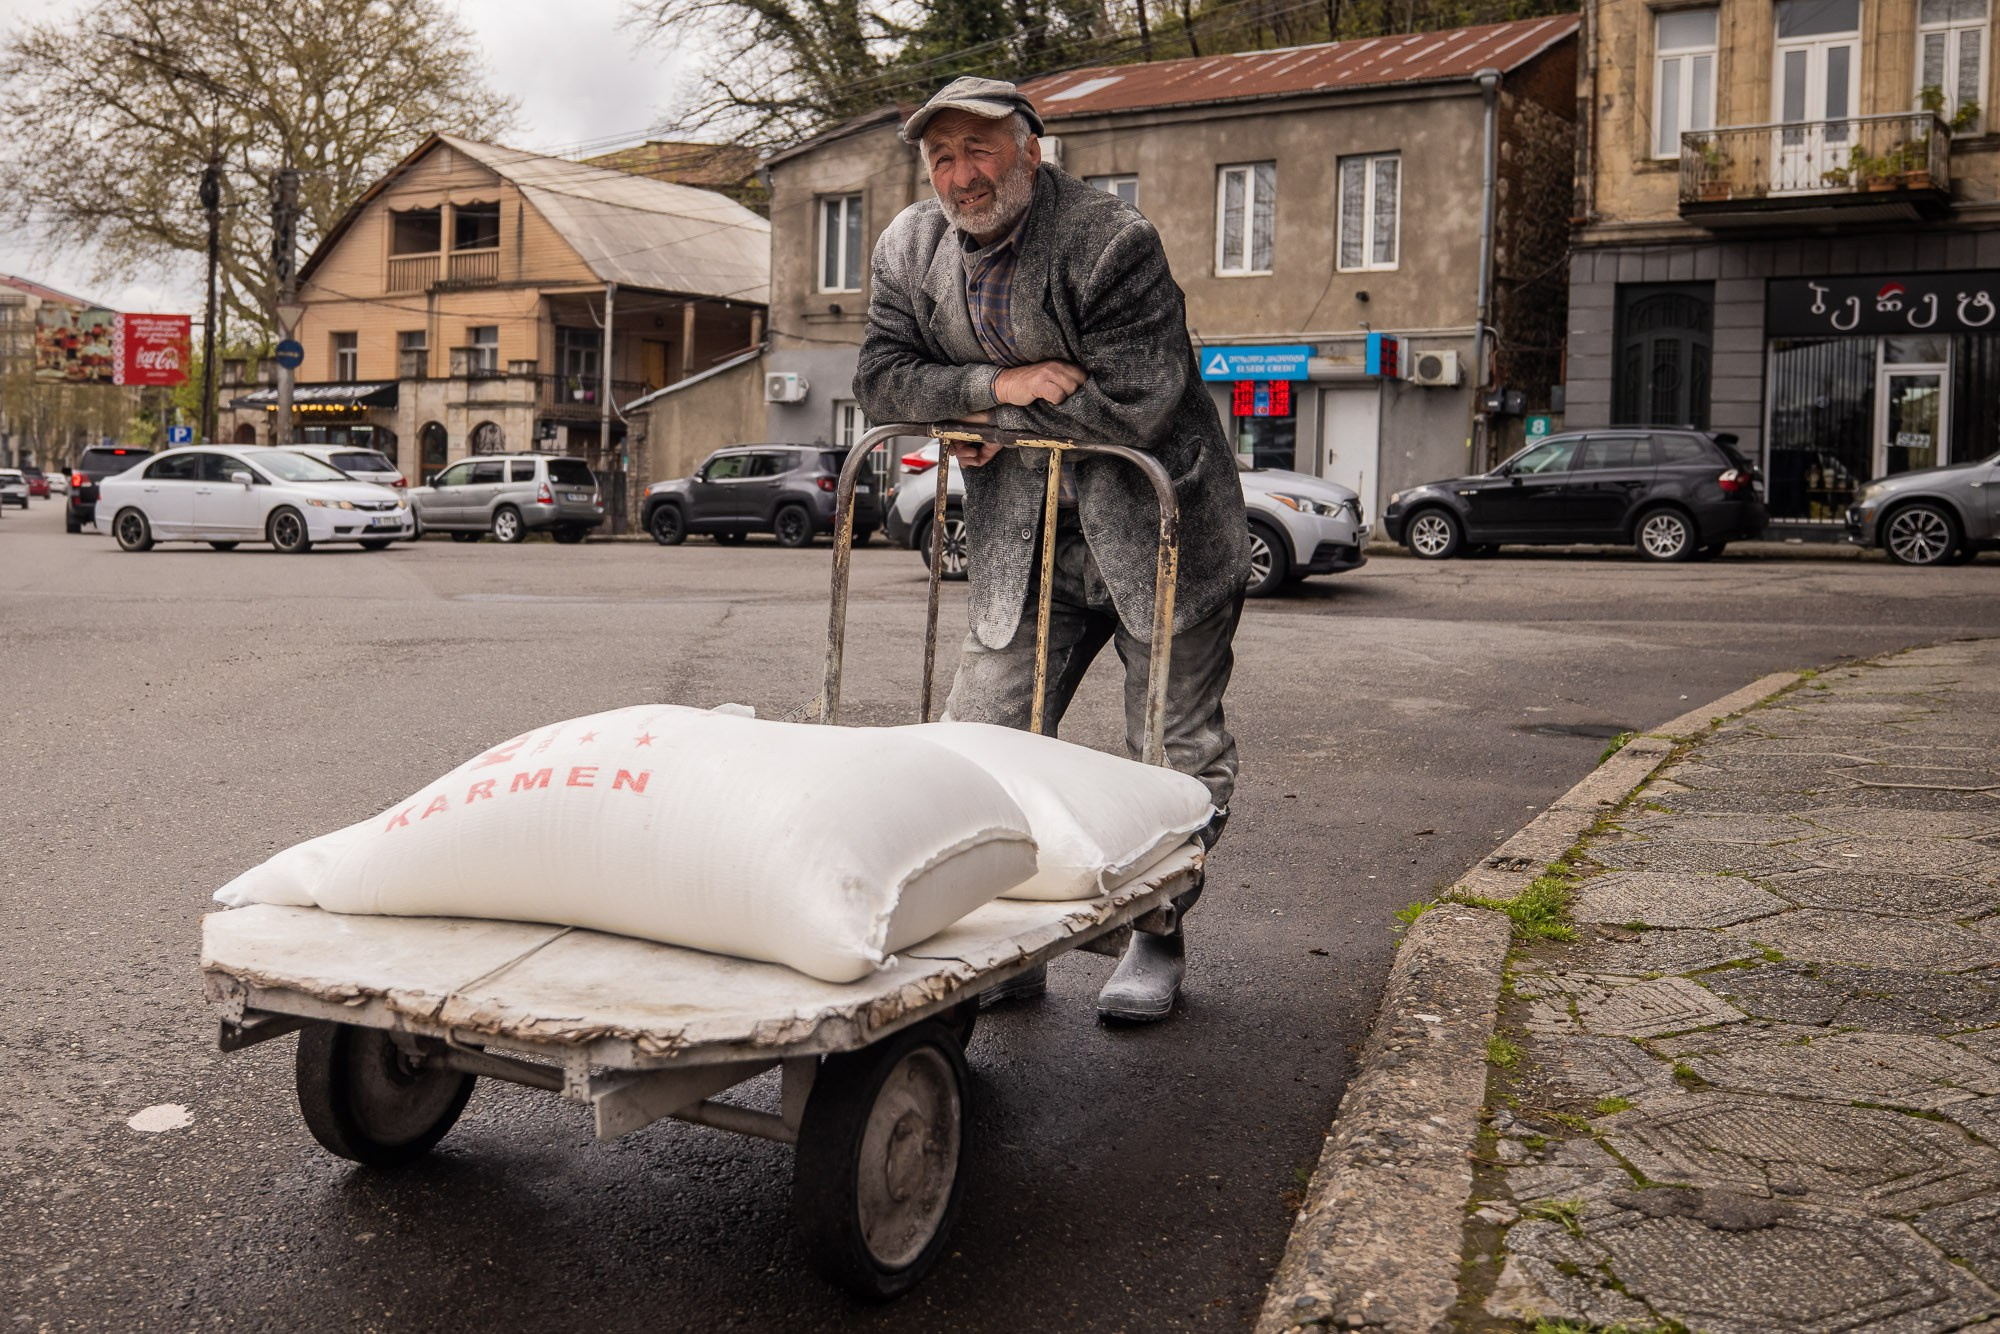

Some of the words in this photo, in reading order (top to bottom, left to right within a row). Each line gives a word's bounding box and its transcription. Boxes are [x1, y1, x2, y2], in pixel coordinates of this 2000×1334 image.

[1267, 363, 1296, 373] CREDIT
[1531, 419, 1545, 434] 8
[175, 427, 187, 442] P
[384, 765, 654, 833] KARMEN
